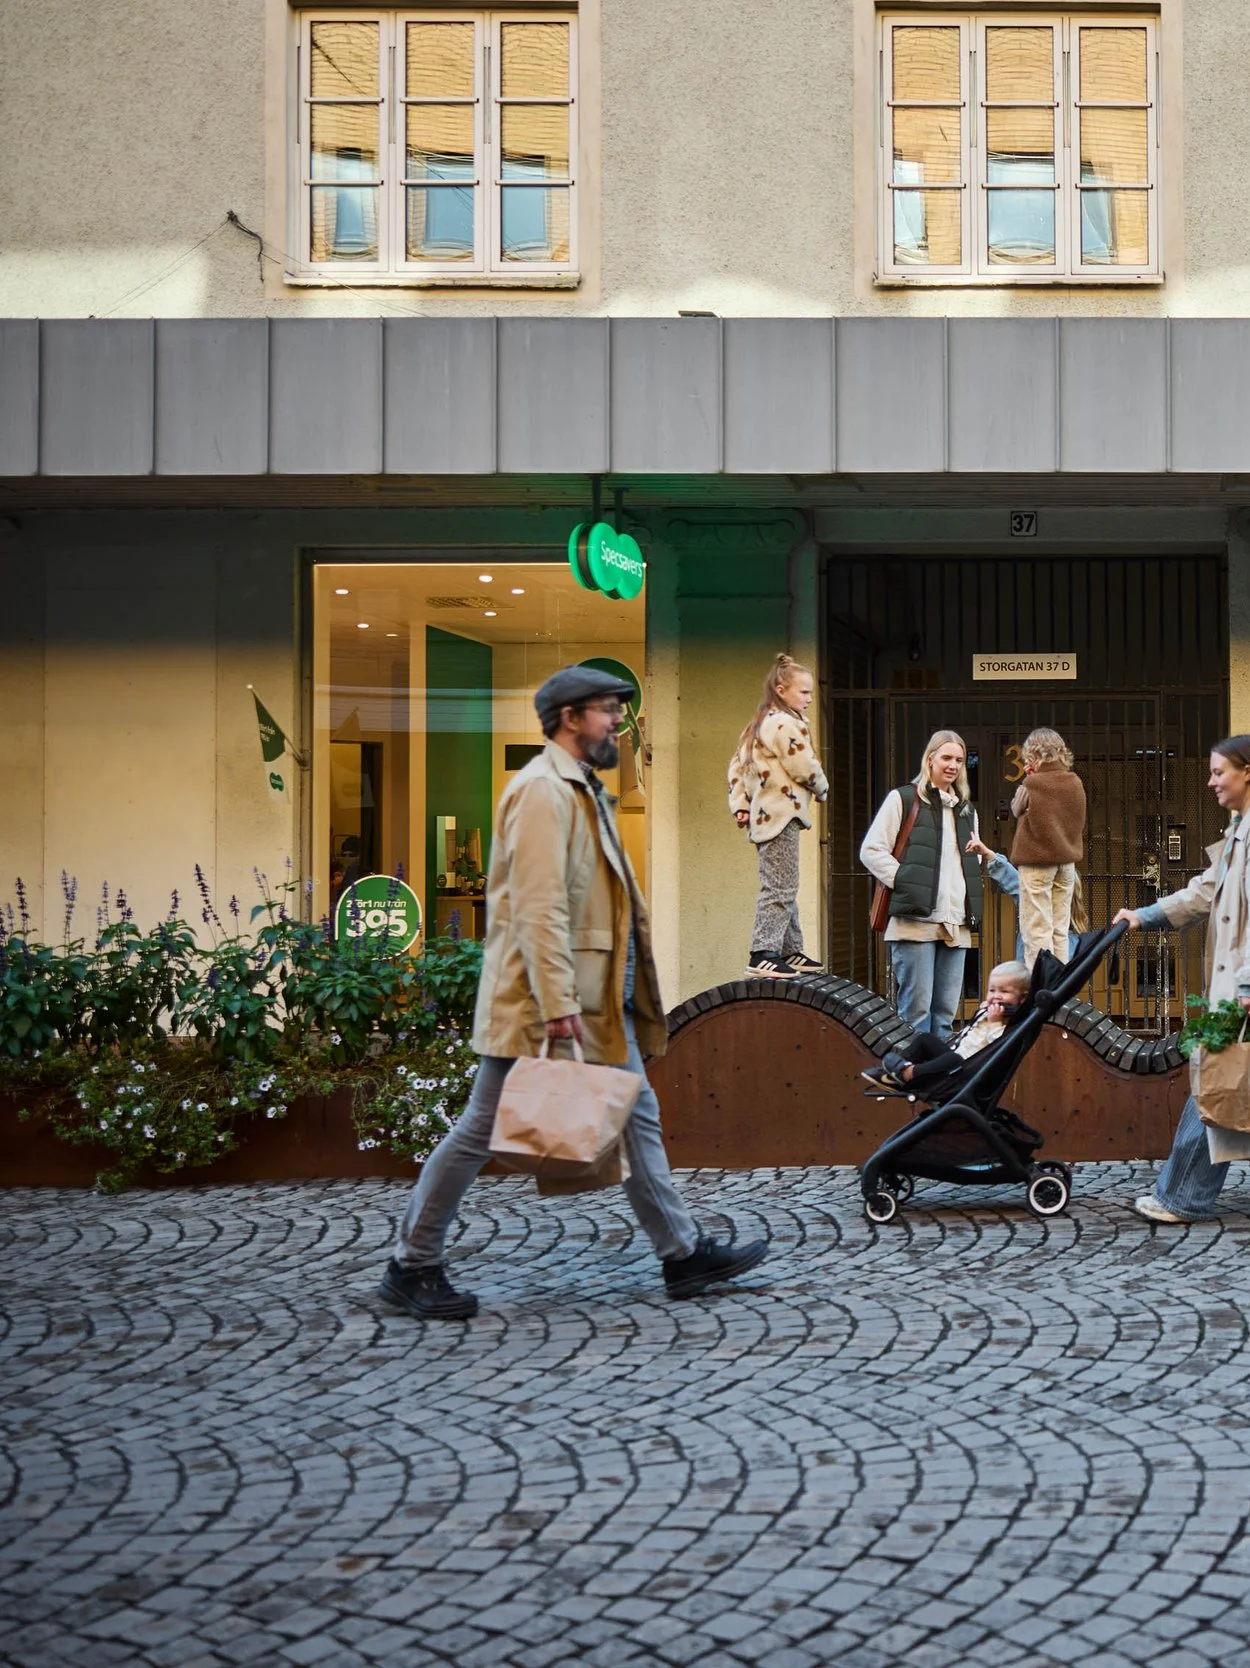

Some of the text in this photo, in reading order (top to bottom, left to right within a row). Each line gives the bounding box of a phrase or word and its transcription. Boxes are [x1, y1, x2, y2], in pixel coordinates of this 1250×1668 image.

[1012, 514, 1035, 532] 37
[601, 540, 642, 577] Specsavers
[979, 661, 1070, 672] STORGATAN 37 D
[346, 909, 408, 937] 395
